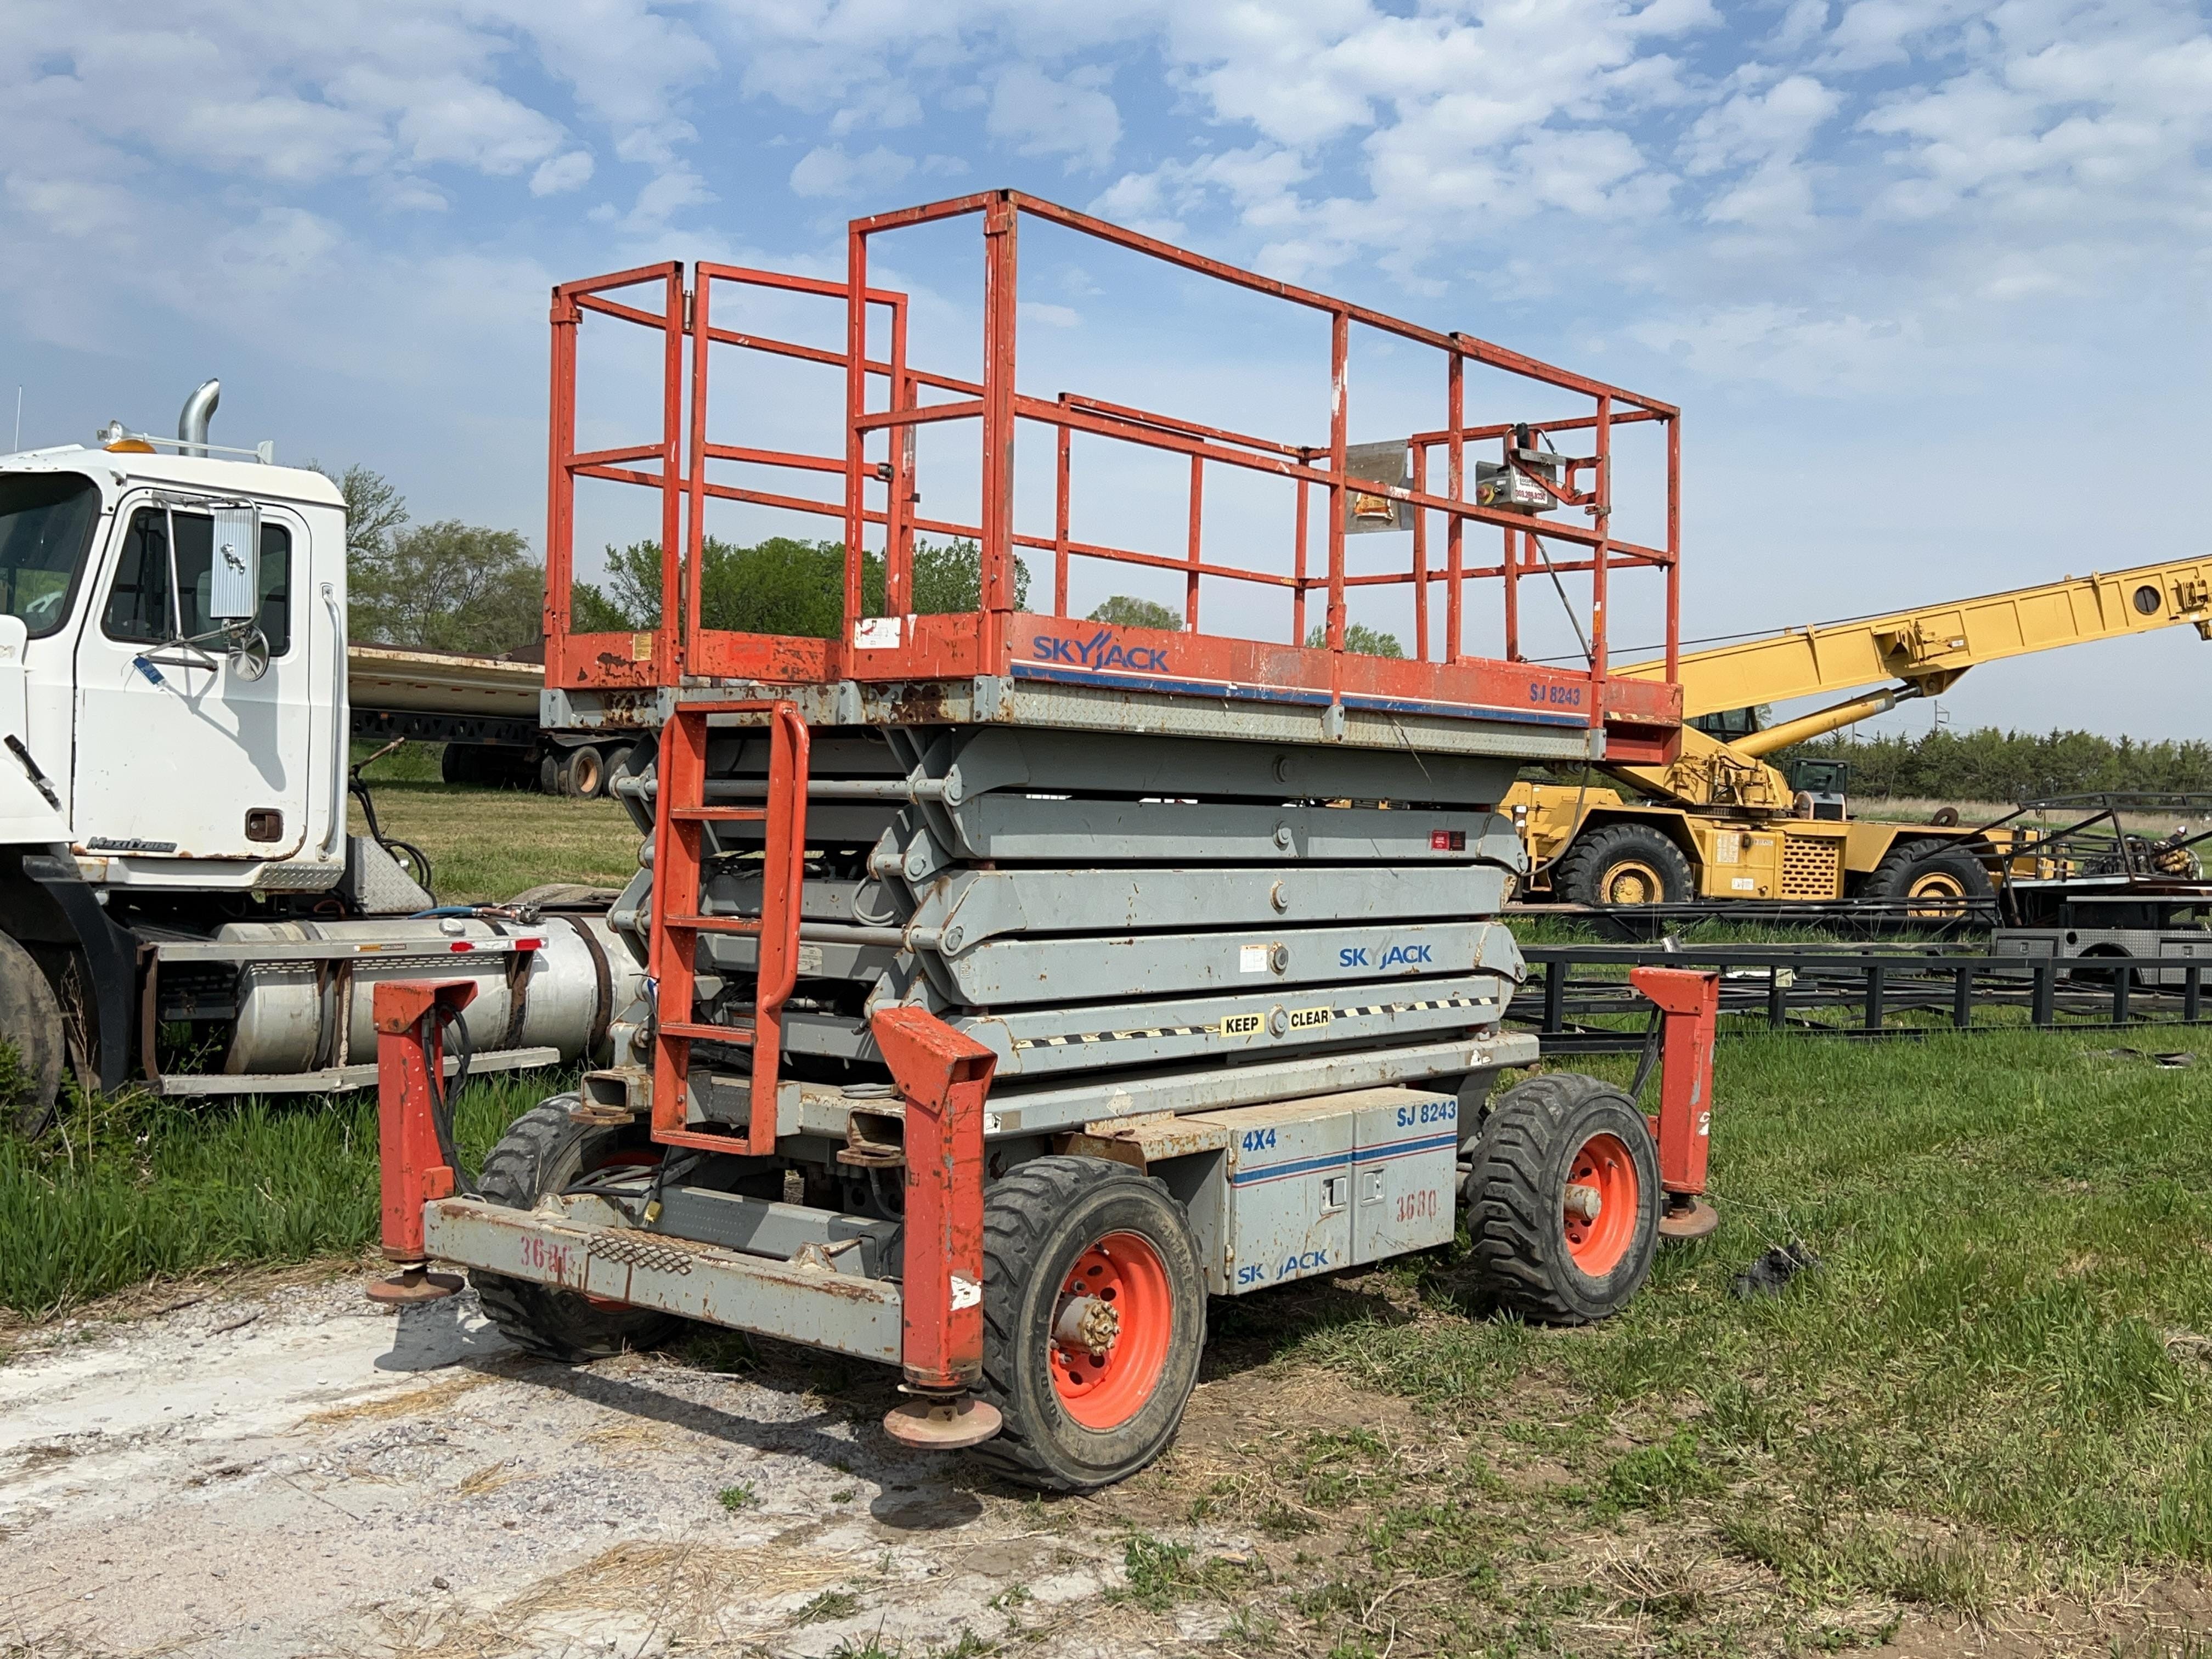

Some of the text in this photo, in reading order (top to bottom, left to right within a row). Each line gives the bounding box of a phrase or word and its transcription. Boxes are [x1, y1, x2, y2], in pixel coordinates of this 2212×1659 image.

[1033, 629, 1169, 672] SKYJACK
[1530, 683, 1580, 707] SJ 8243
[1226, 1009, 1328, 1033] KEEP CLEAR
[1397, 1101, 1456, 1127] SJ 8243
[1243, 1128, 1276, 1152] 4X4
[1397, 1190, 1437, 1223] 3680
